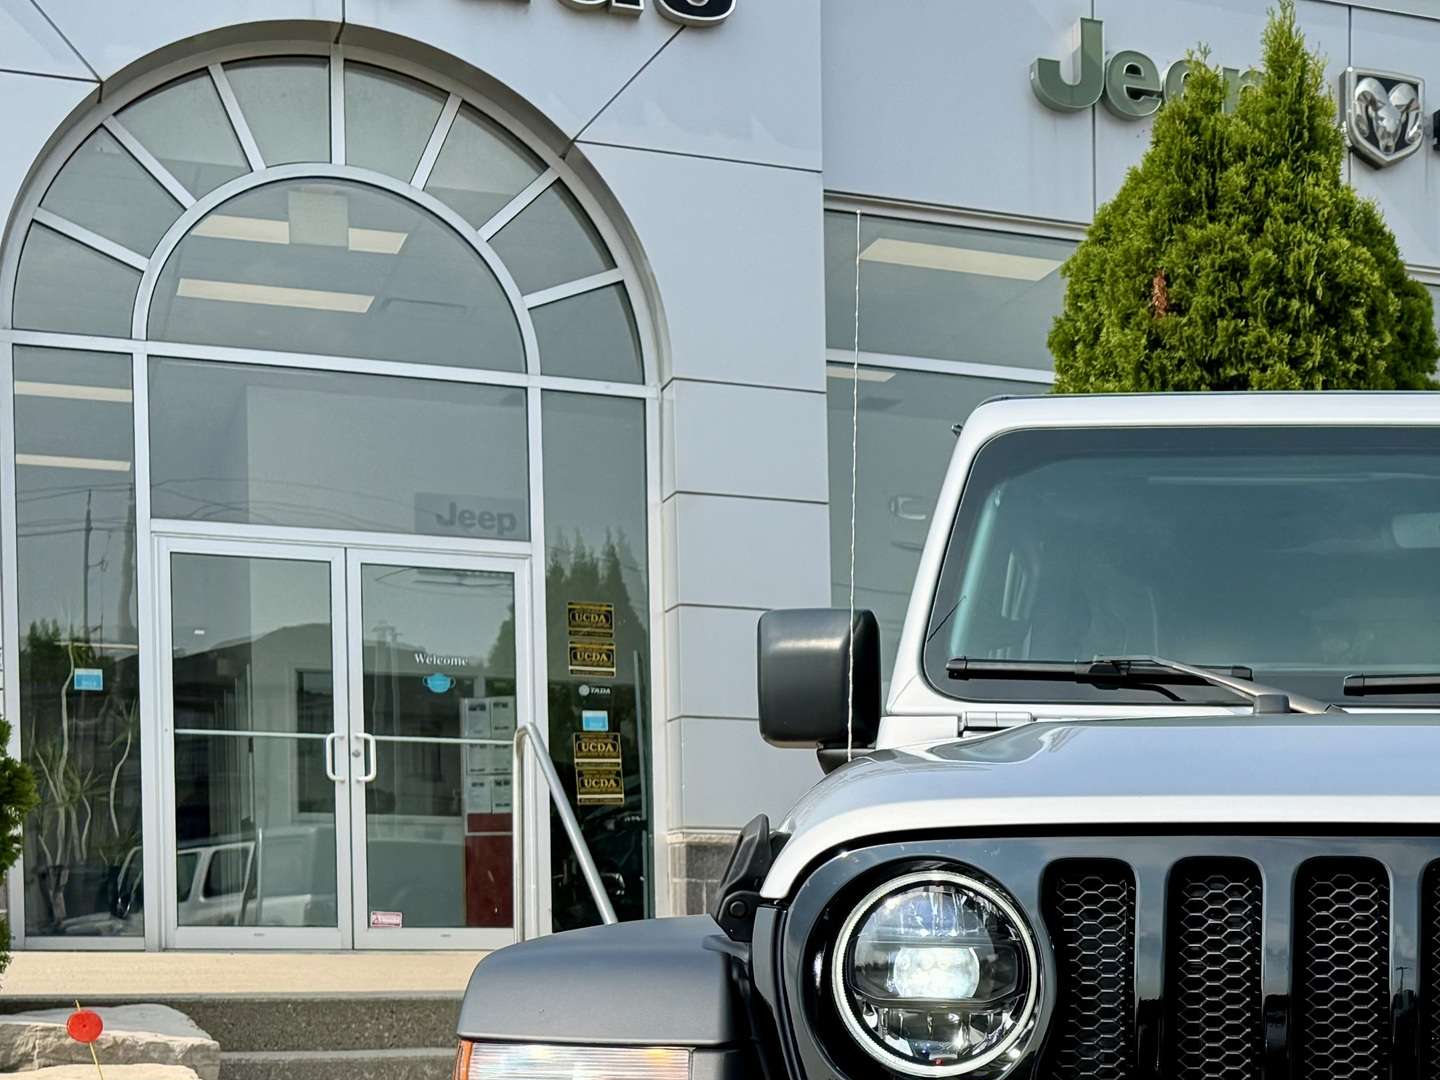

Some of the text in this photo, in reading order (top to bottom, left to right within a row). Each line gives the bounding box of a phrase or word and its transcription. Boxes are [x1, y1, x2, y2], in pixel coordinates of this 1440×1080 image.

[435, 502, 517, 536] Jeep
[575, 612, 606, 624] UCDA
[414, 652, 469, 667] Welcome
[576, 651, 608, 662] UCDA
[581, 742, 615, 753] UCDA
[584, 779, 617, 789] UCDA
